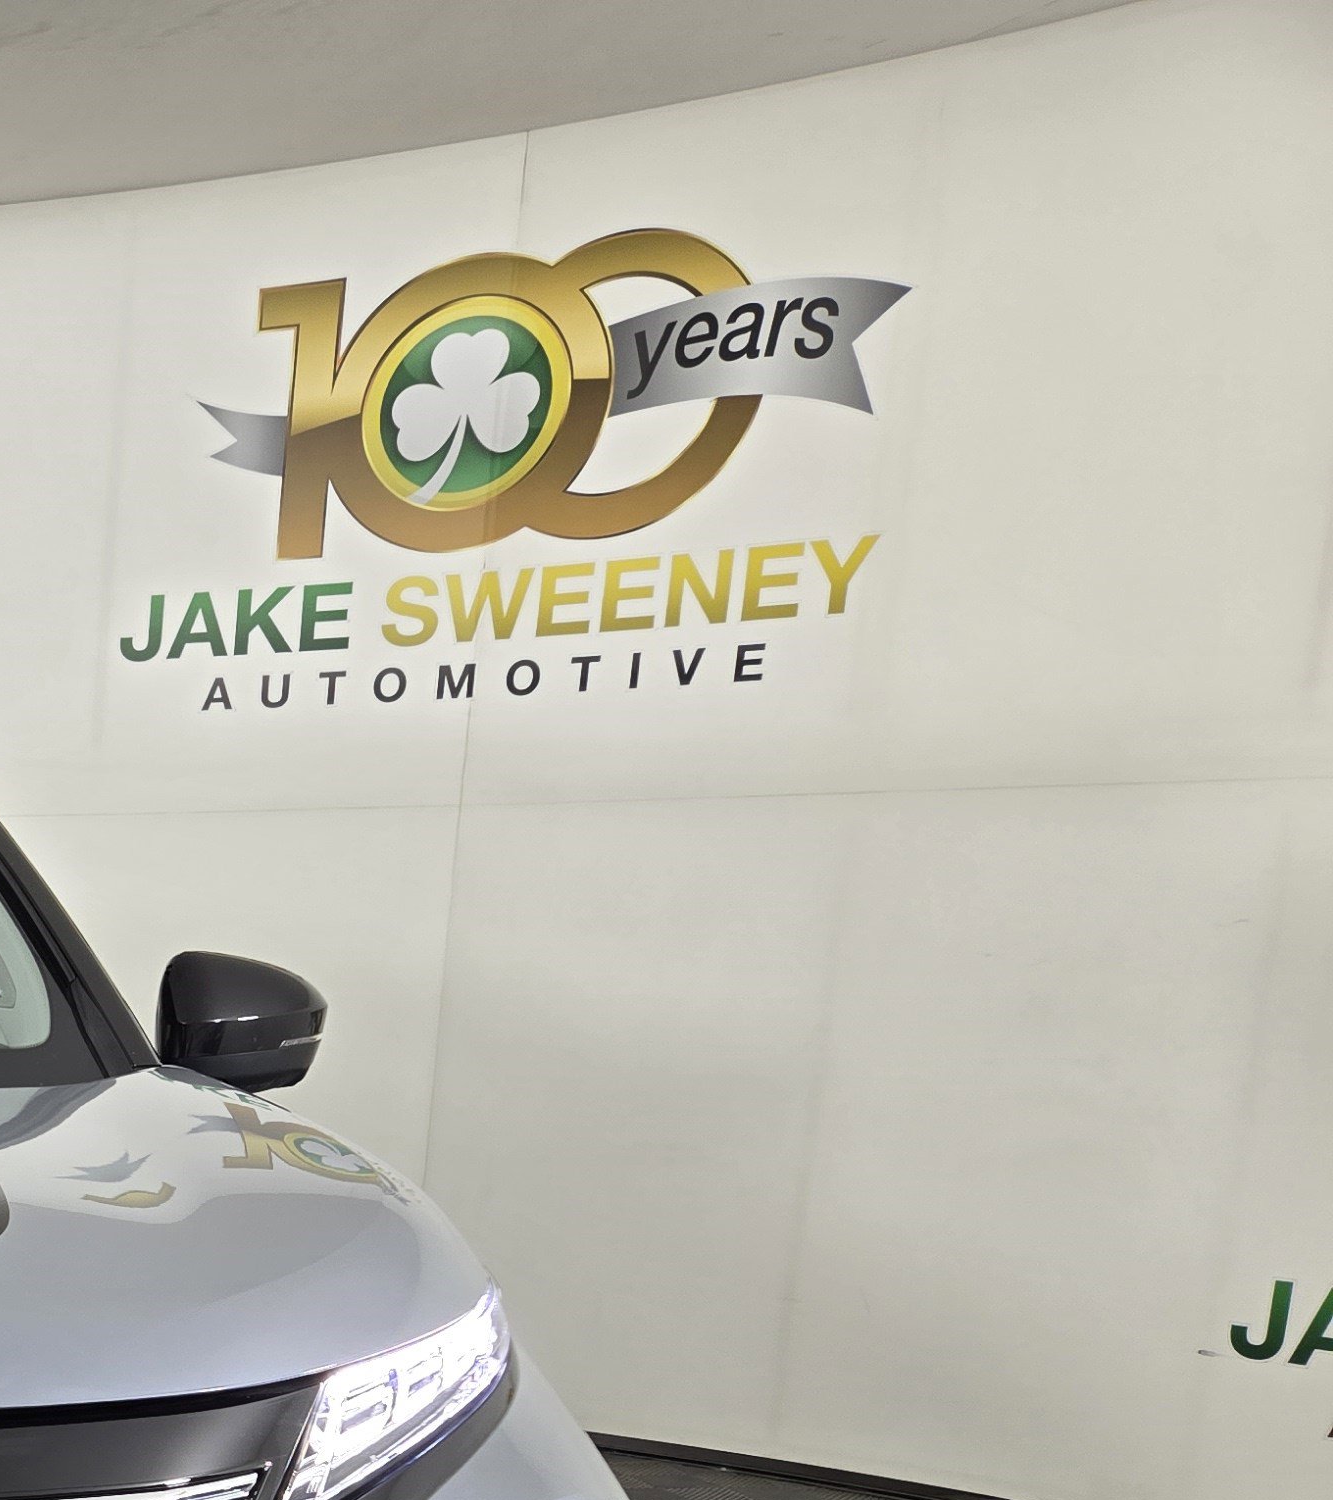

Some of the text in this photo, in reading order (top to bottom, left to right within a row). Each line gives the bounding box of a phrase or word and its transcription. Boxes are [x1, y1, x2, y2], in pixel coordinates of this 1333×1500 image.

[256, 227, 763, 559] 100
[627, 293, 839, 399] years
[119, 533, 881, 662] JAKE SWEENEY
[201, 642, 768, 712] AUTOMOTIVE
